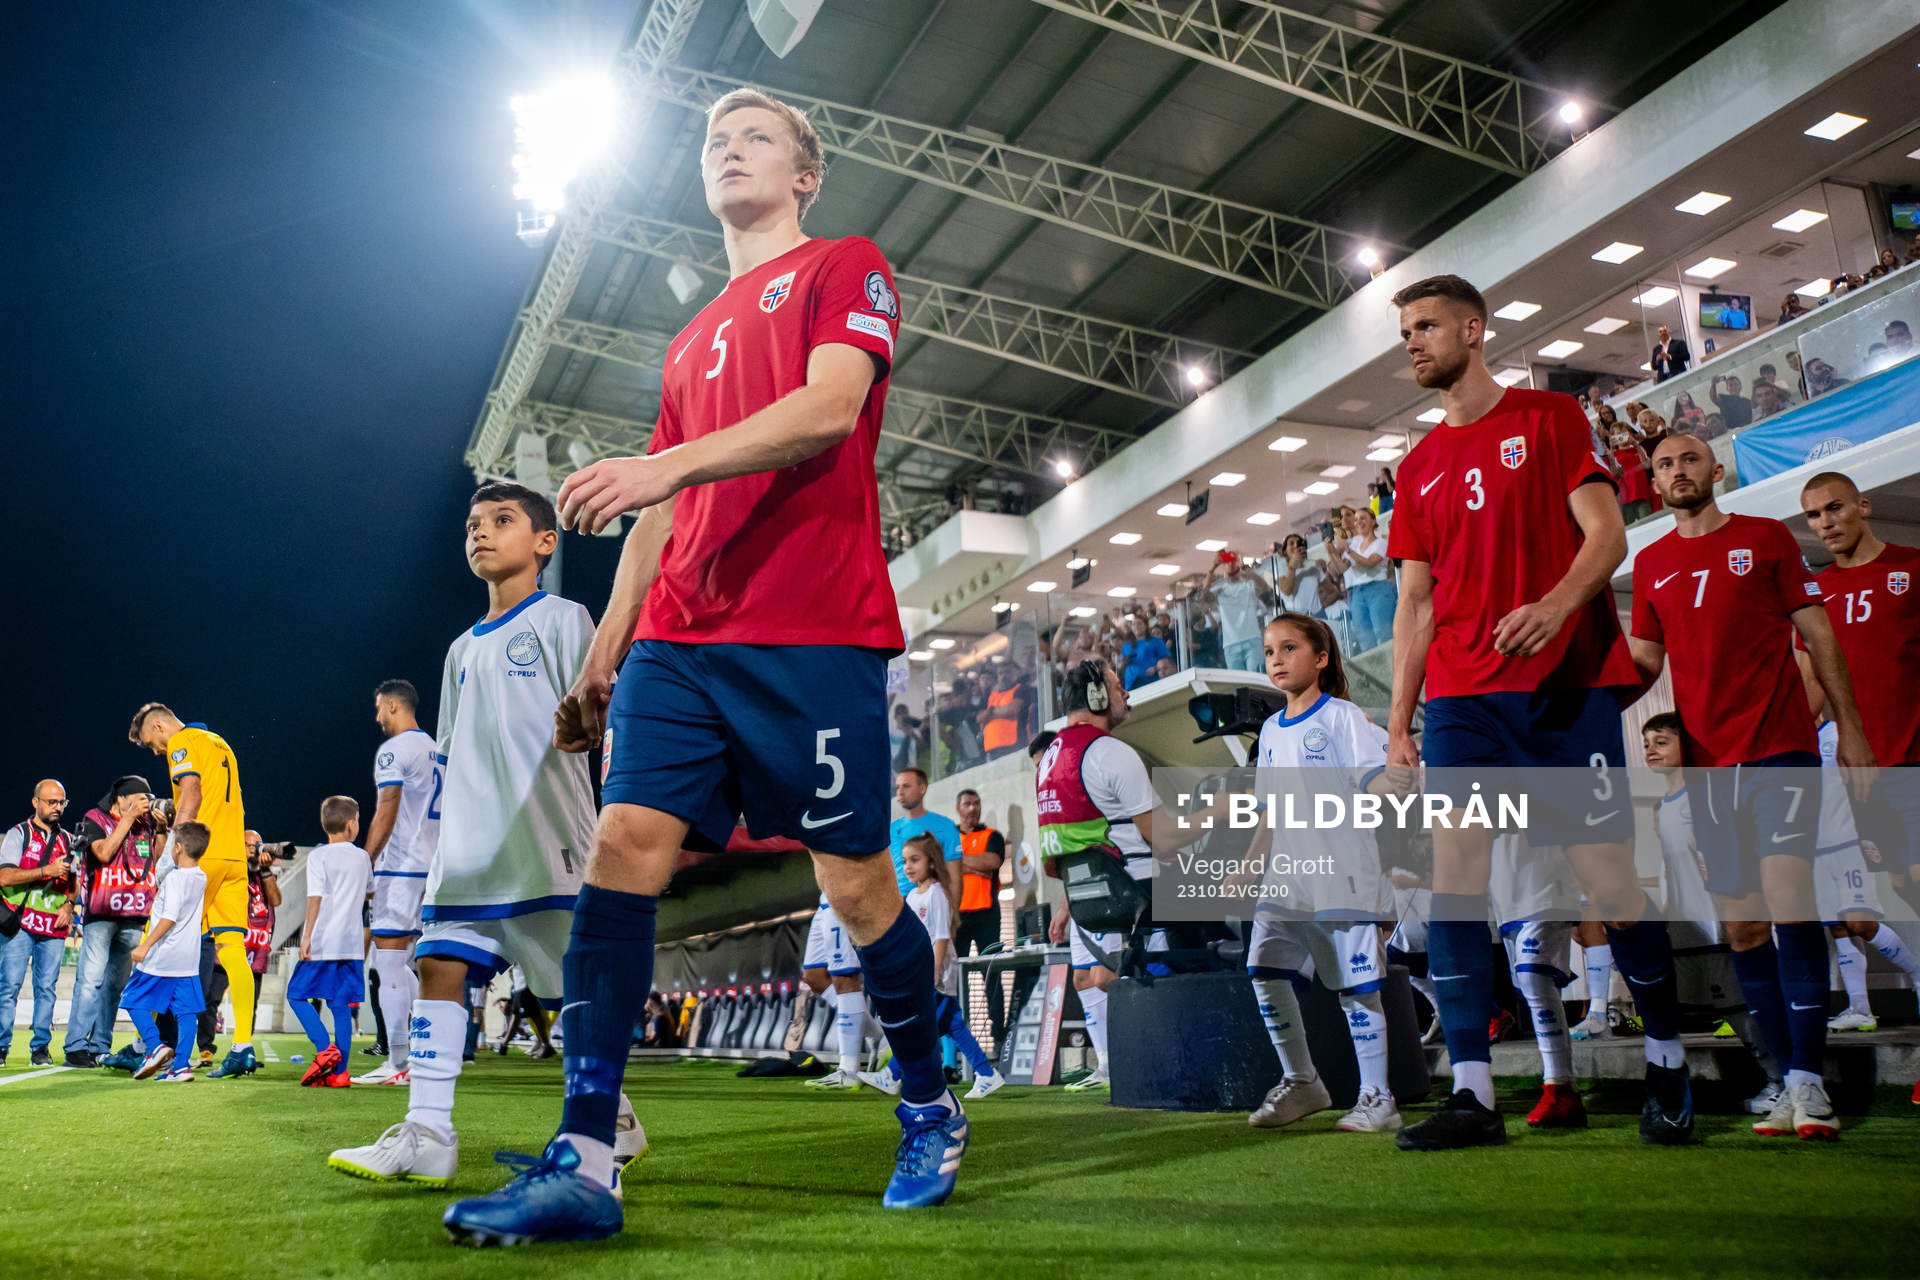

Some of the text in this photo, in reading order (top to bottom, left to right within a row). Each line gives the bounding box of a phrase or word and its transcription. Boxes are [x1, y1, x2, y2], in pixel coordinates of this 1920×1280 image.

[706, 317, 734, 380] 5
[1464, 467, 1486, 511] 3
[1691, 569, 1711, 609] 7
[1844, 589, 1874, 624] 15
[507, 670, 537, 678] CYPRUS
[221, 754, 232, 803] 1
[815, 727, 846, 800] 5
[1589, 751, 1613, 802] 3
[1783, 786, 1805, 824] 7
[1844, 868, 1864, 890] 16
[109, 892, 147, 912] 623
[20, 911, 54, 934] 431
